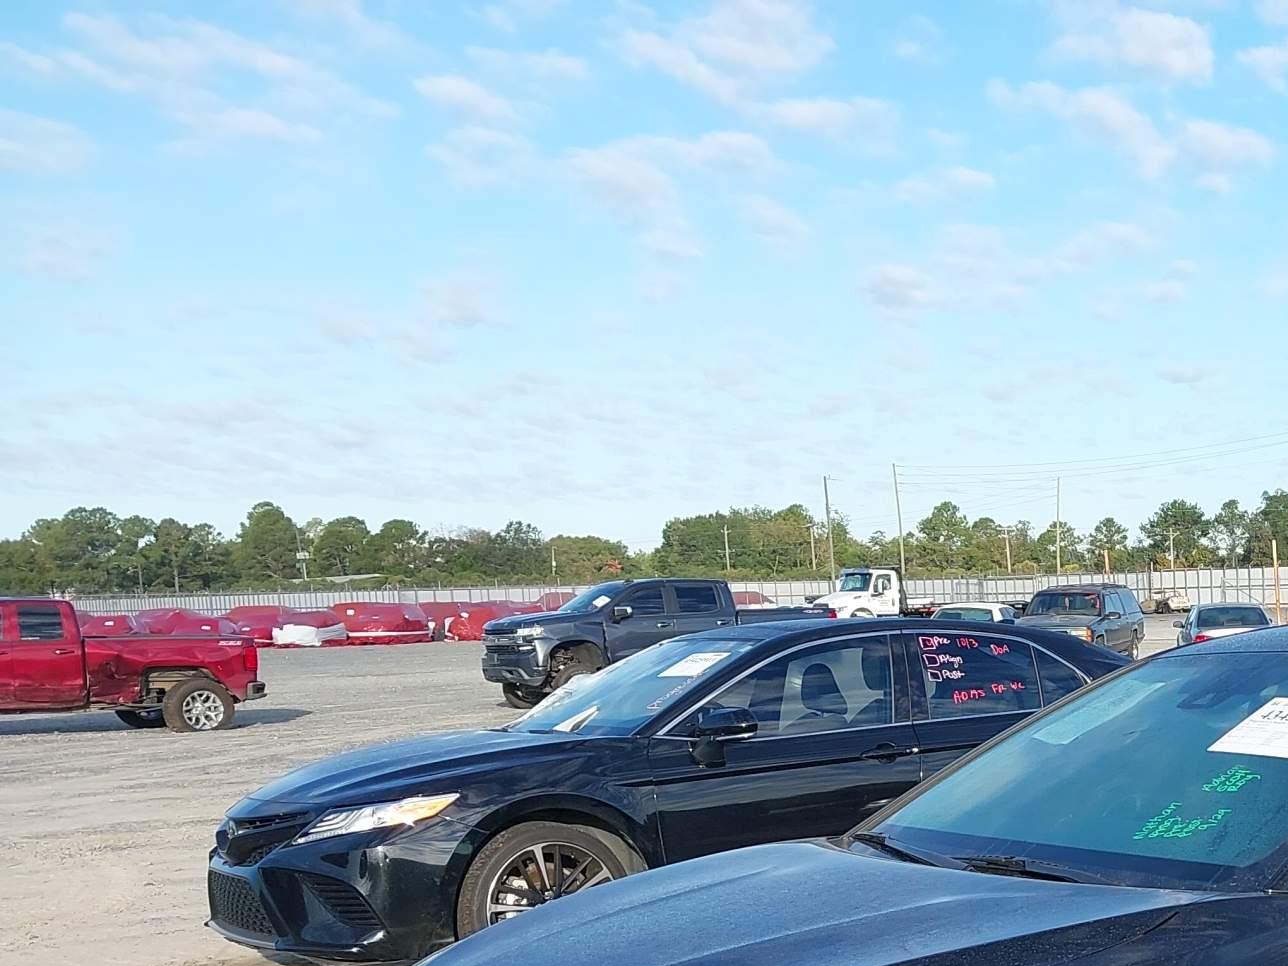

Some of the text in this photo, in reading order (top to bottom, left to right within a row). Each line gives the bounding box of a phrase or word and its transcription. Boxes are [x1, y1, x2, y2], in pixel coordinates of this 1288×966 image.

[939, 654, 964, 668] Align
[942, 669, 966, 680] Post
[1133, 801, 1182, 840] Nathan
